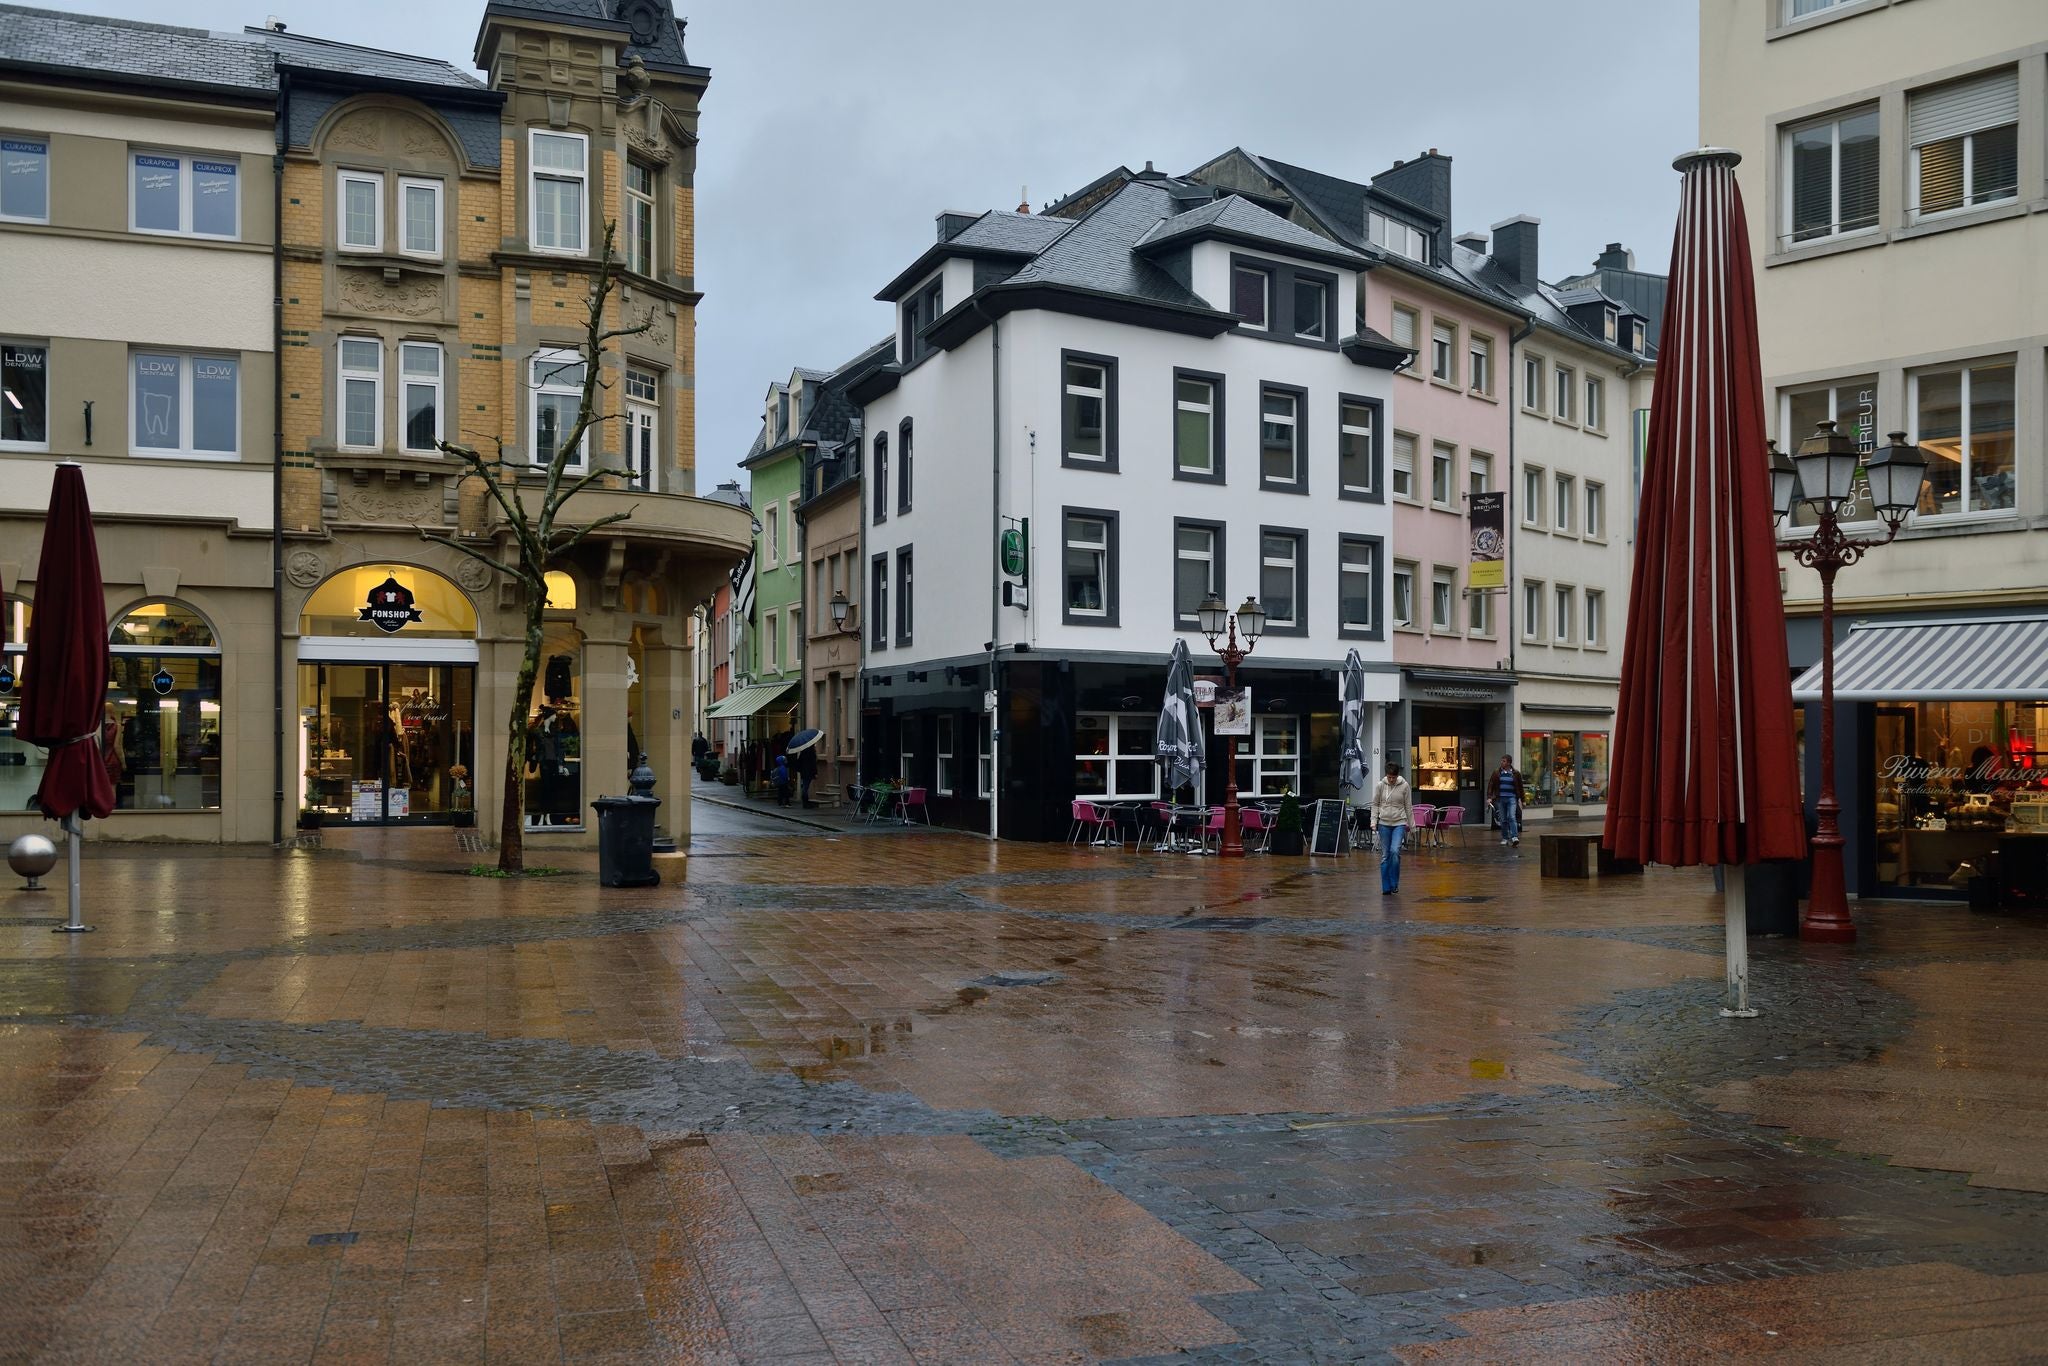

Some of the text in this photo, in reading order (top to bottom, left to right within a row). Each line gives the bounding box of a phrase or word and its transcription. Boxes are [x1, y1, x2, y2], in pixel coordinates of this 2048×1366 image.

[139, 157, 176, 168] CURAPROX
[196, 163, 232, 173] CURAPROX
[5, 352, 42, 363] LDW
[5, 361, 42, 369] DENTAIRE
[140, 361, 175, 372] LDW
[197, 365, 232, 376] LDW
[372, 609, 411, 619] FONSHOP
[1965, 755, 2048, 781] Maison
